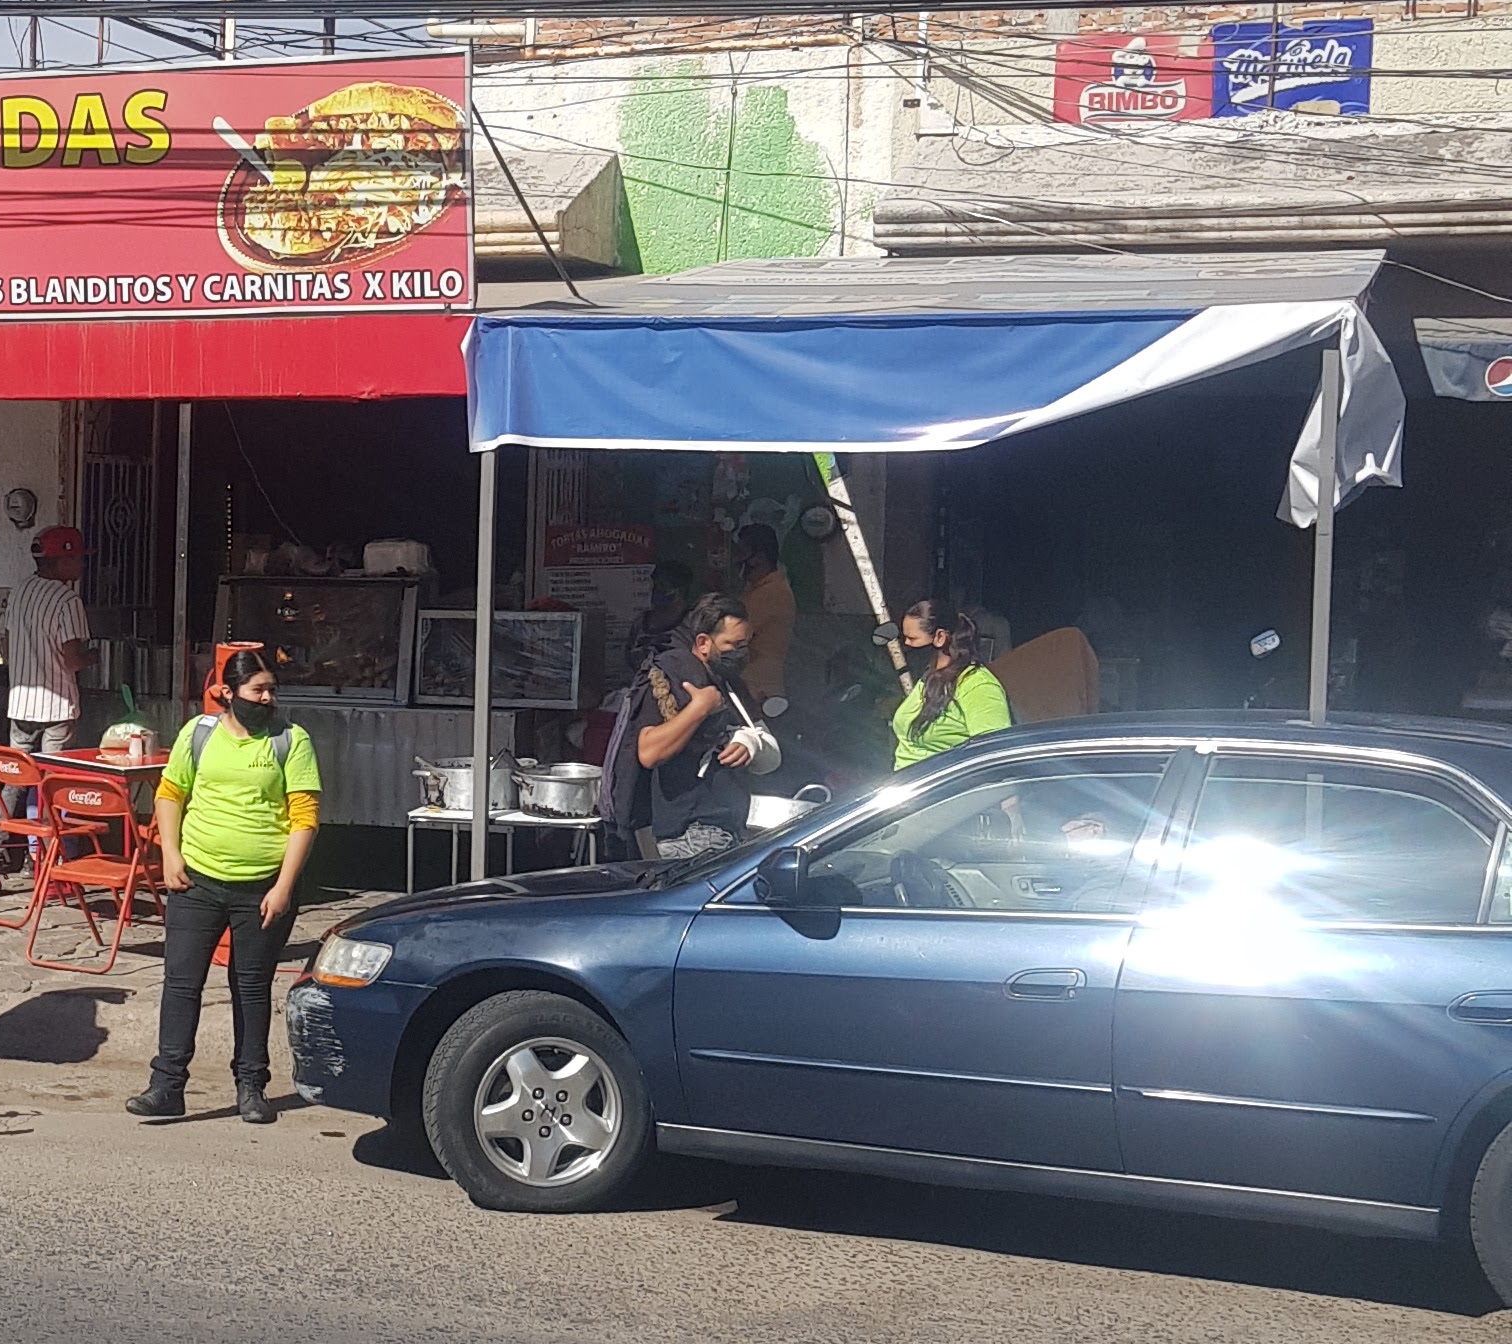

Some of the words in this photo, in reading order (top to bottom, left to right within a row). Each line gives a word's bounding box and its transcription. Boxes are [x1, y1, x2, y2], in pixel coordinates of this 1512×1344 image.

[1088, 89, 1179, 112] BIMBO
[10, 275, 172, 305] BLANDITOS
[175, 276, 197, 302] Y
[203, 273, 350, 302] CARNITAS
[363, 273, 384, 300] X
[391, 270, 464, 299] KILO
